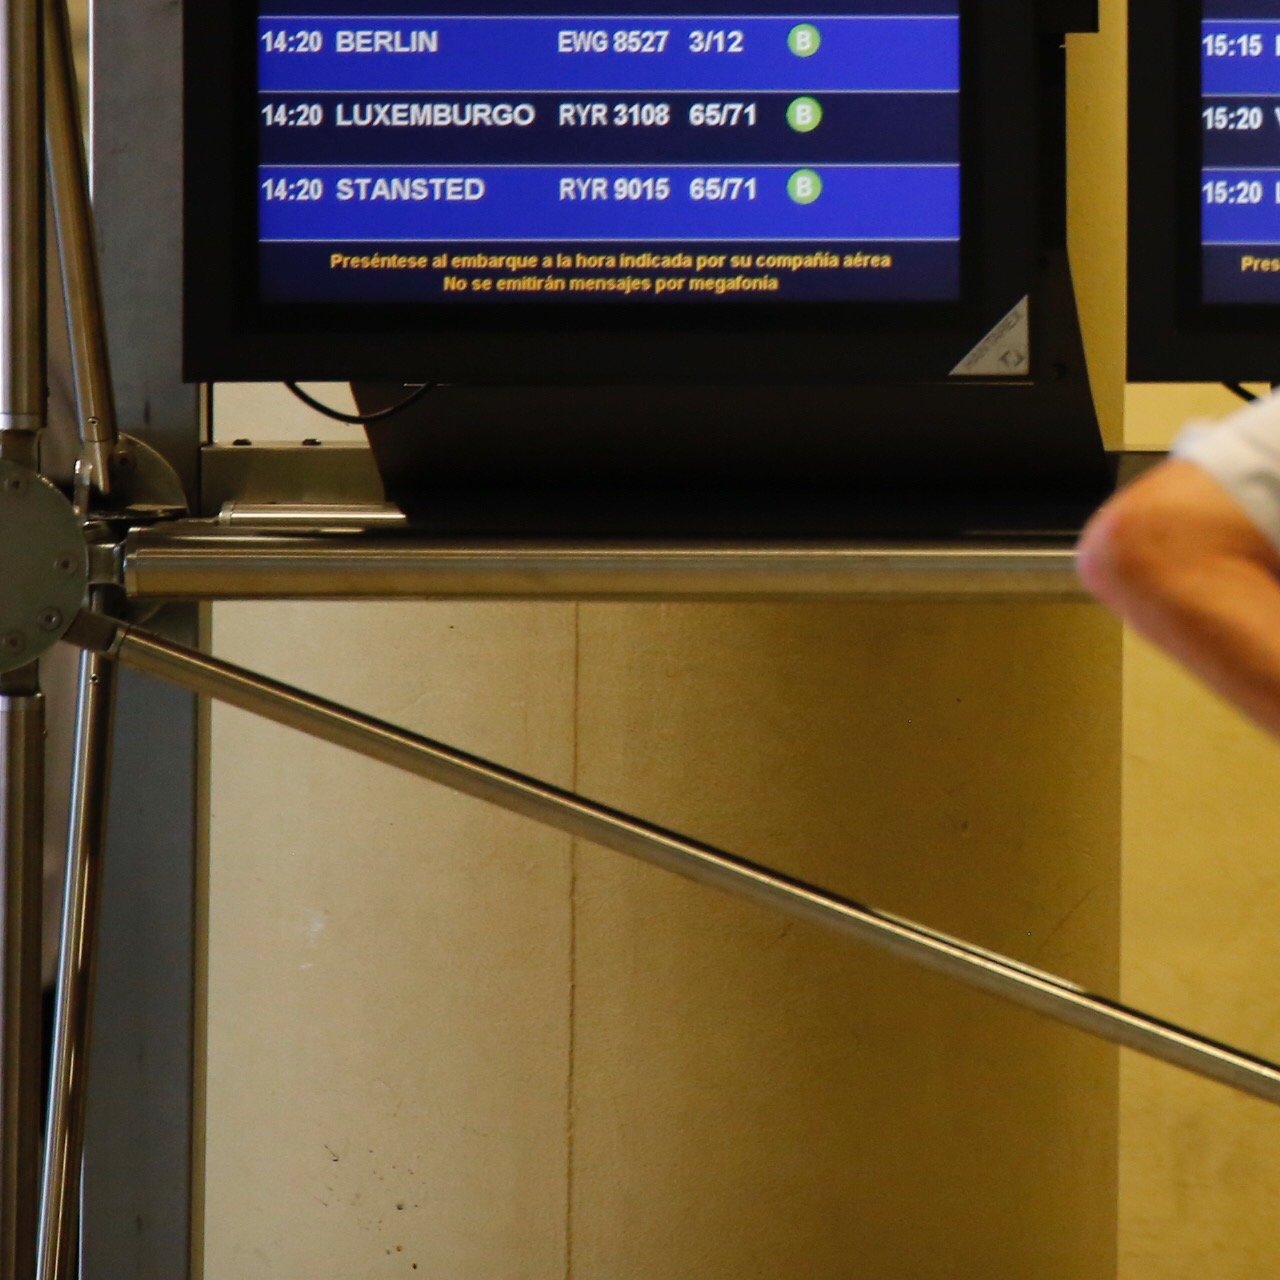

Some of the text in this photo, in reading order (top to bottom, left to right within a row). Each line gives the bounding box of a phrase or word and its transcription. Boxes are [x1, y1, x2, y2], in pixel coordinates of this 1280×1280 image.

[1202, 33, 1263, 57] 15:15
[330, 251, 892, 272] Preséntese al embarque a la hora indicada por su compañía aérea
[443, 274, 779, 295] No se emitirán mensajes por megafonía
